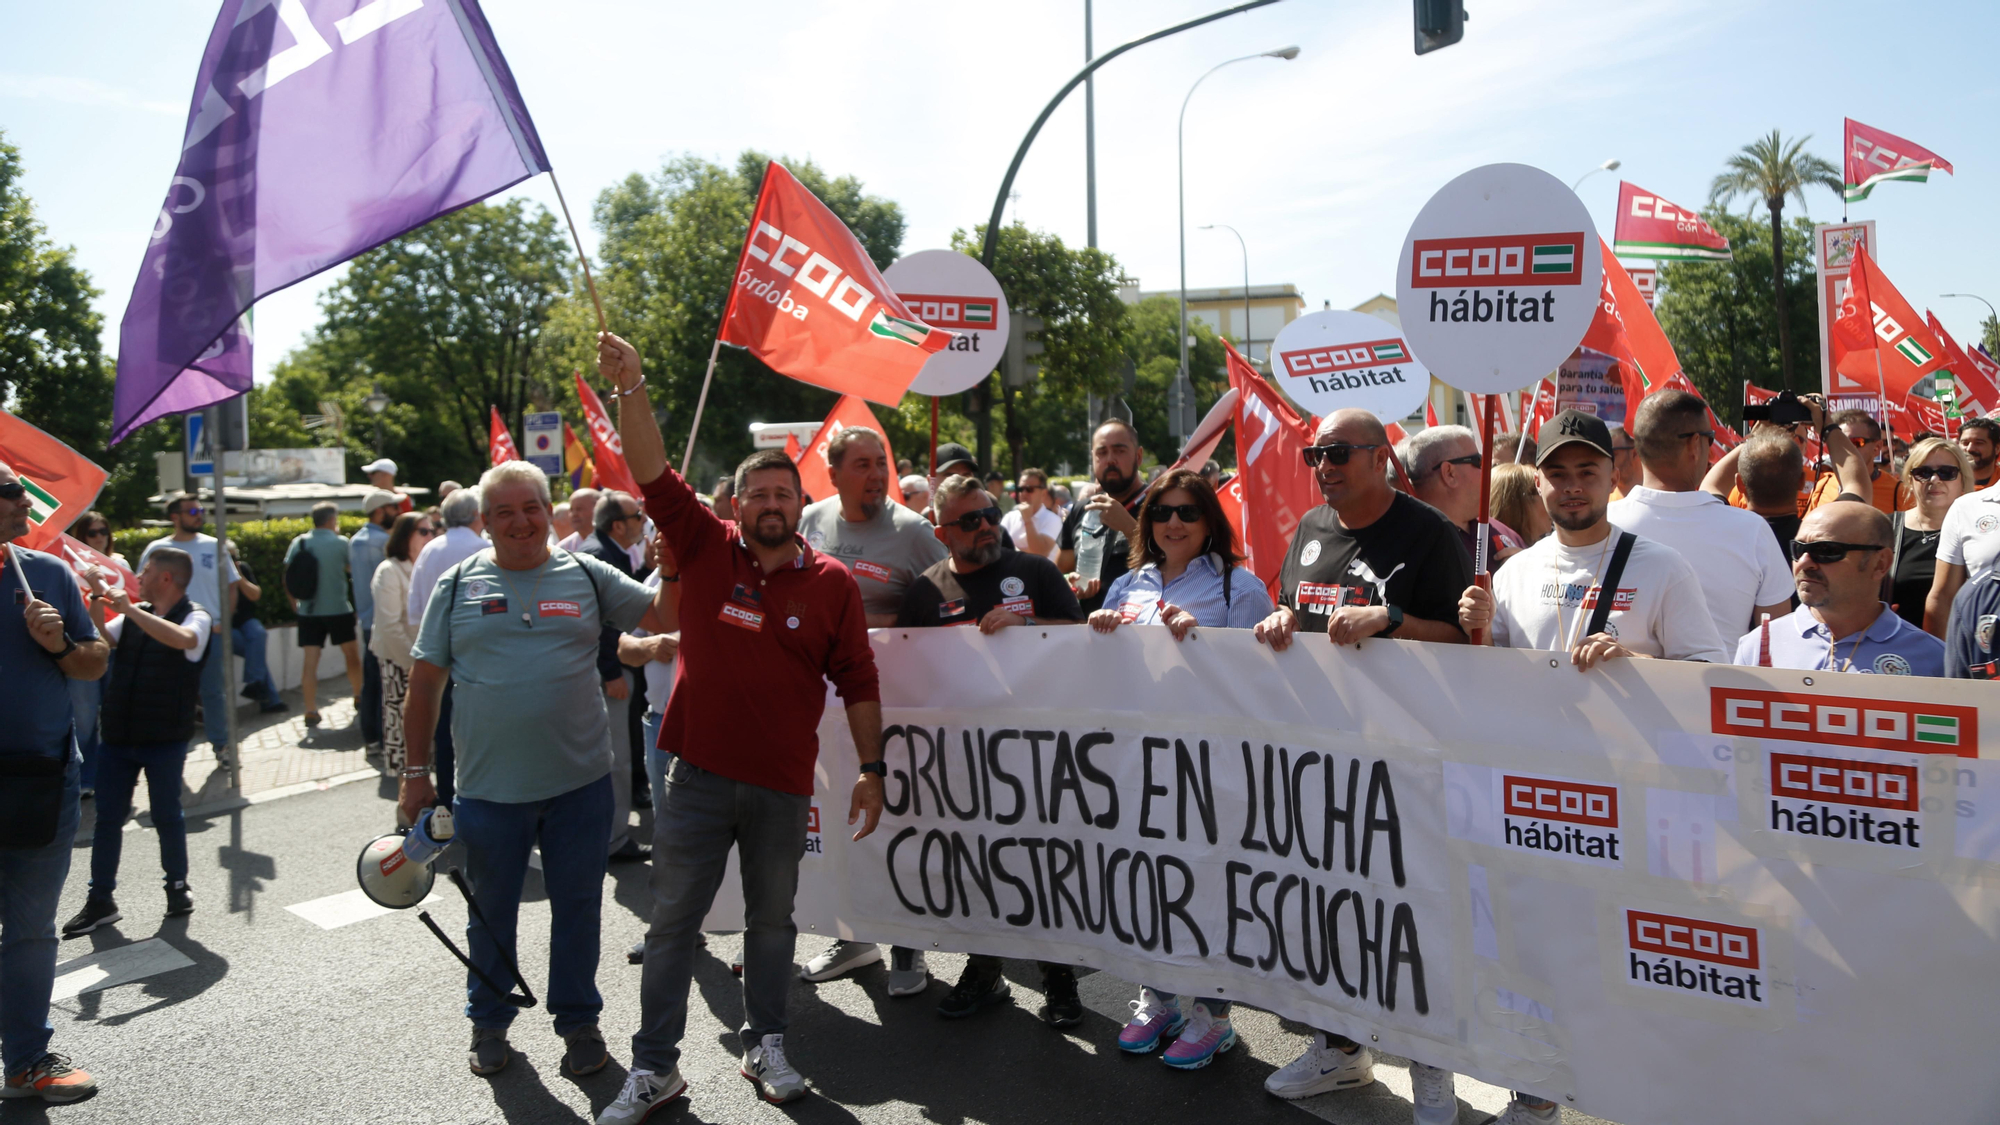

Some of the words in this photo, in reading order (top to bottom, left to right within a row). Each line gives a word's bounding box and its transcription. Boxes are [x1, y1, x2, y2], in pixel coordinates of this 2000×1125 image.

[748, 219, 876, 322] CCOO
[1419, 246, 1525, 278] CCOO
[737, 268, 809, 322] órdoba
[905, 301, 960, 321] COO
[1429, 289, 1555, 323] hábitat
[1288, 347, 1372, 372] CCOO
[1308, 366, 1406, 393] hábitat
[1559, 384, 1583, 394] para
[1586, 383, 1597, 393] tu
[1829, 398, 1879, 413] SANIDAD
[855, 562, 882, 575] CCOO
[540, 602, 572, 611] CCOO
[1301, 586, 1330, 596] CCOO
[723, 605, 754, 622] CCOO
[1725, 698, 1908, 741] CCOO
[1780, 762, 1908, 801] CCOO
[881, 724, 1119, 830] GRUISTAS
[1138, 736, 1218, 845] EN
[1240, 740, 1406, 888] LUCHA
[1511, 784, 1610, 819] CCOO
[1504, 818, 1619, 860] hábitat
[1771, 800, 1920, 848] hábitat
[887, 826, 1210, 958] CONSTRUCOR
[1226, 860, 1429, 1016] ESCUCHA
[1636, 919, 1750, 960] CCOO
[1629, 952, 1762, 1002] hábitat
